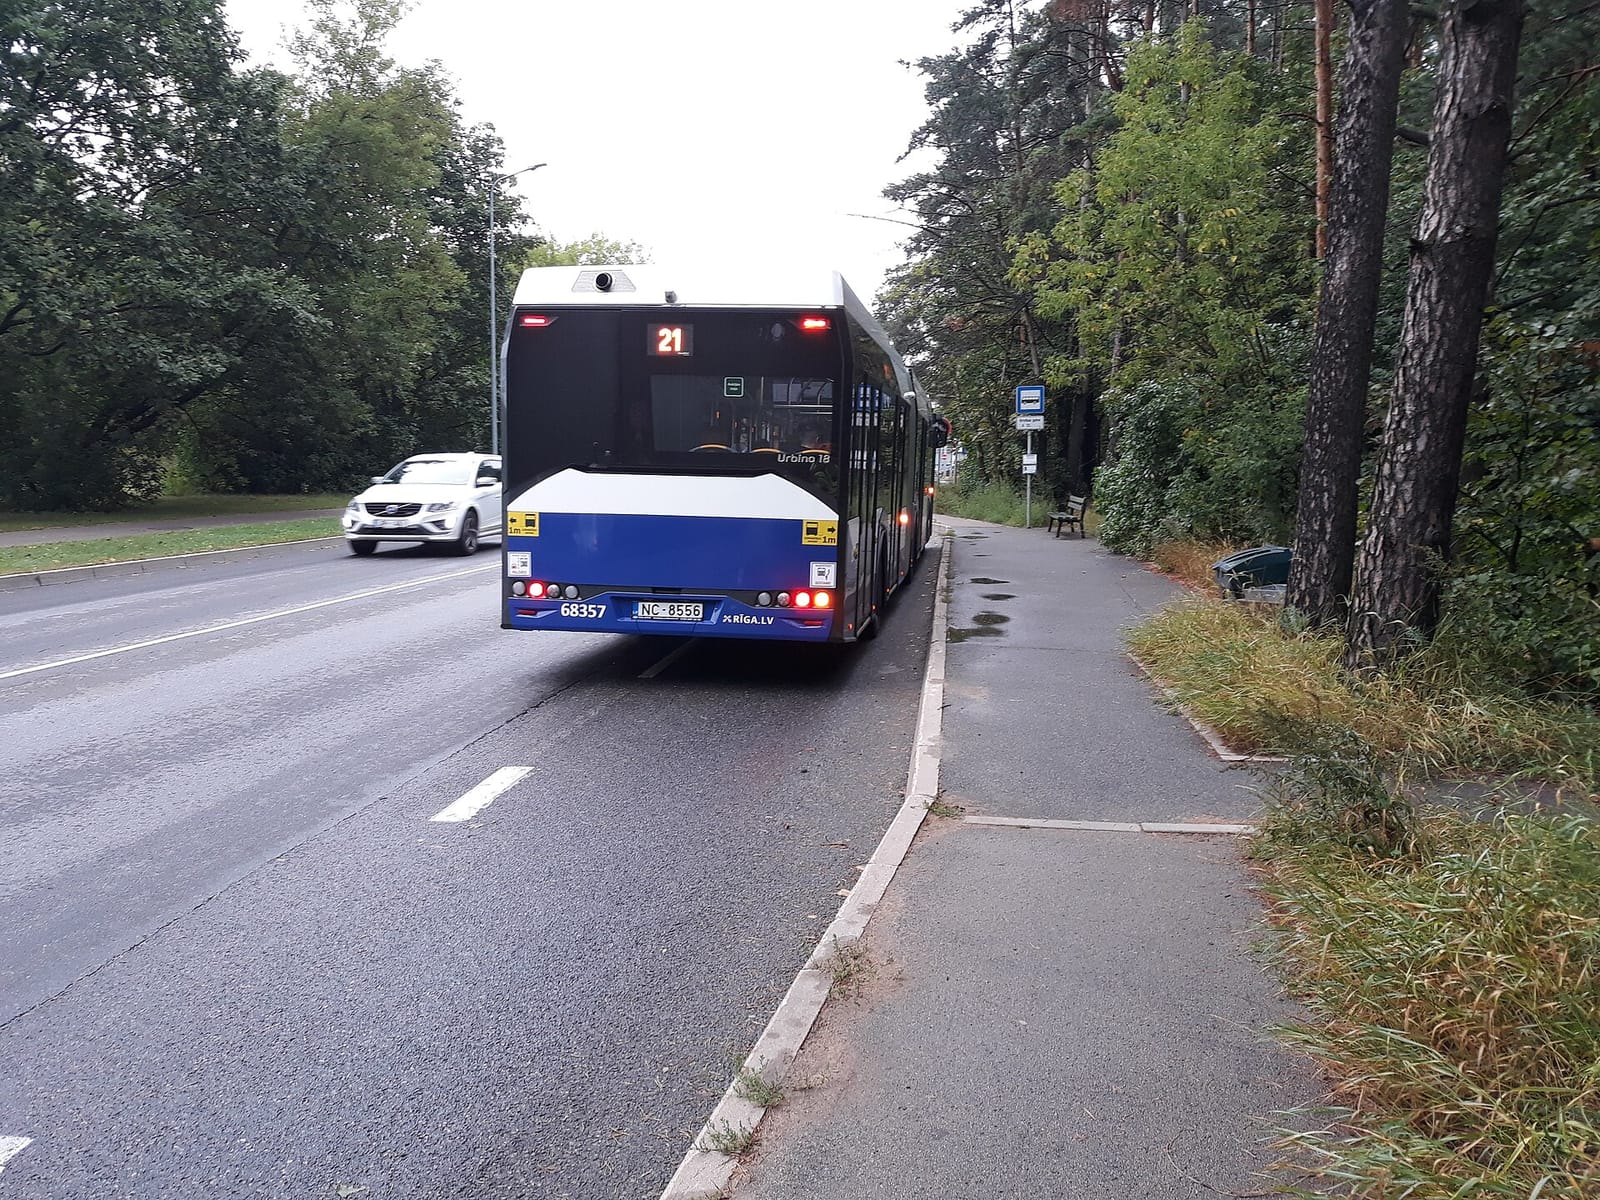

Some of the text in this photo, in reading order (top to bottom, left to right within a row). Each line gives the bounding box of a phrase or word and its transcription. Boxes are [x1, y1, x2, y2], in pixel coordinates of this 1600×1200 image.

[658, 327, 682, 352] 21
[777, 453, 831, 464] Urbino 18
[822, 536, 836, 544] 1m
[560, 603, 607, 619] 68357
[732, 613, 775, 625] RĪGA.LV
